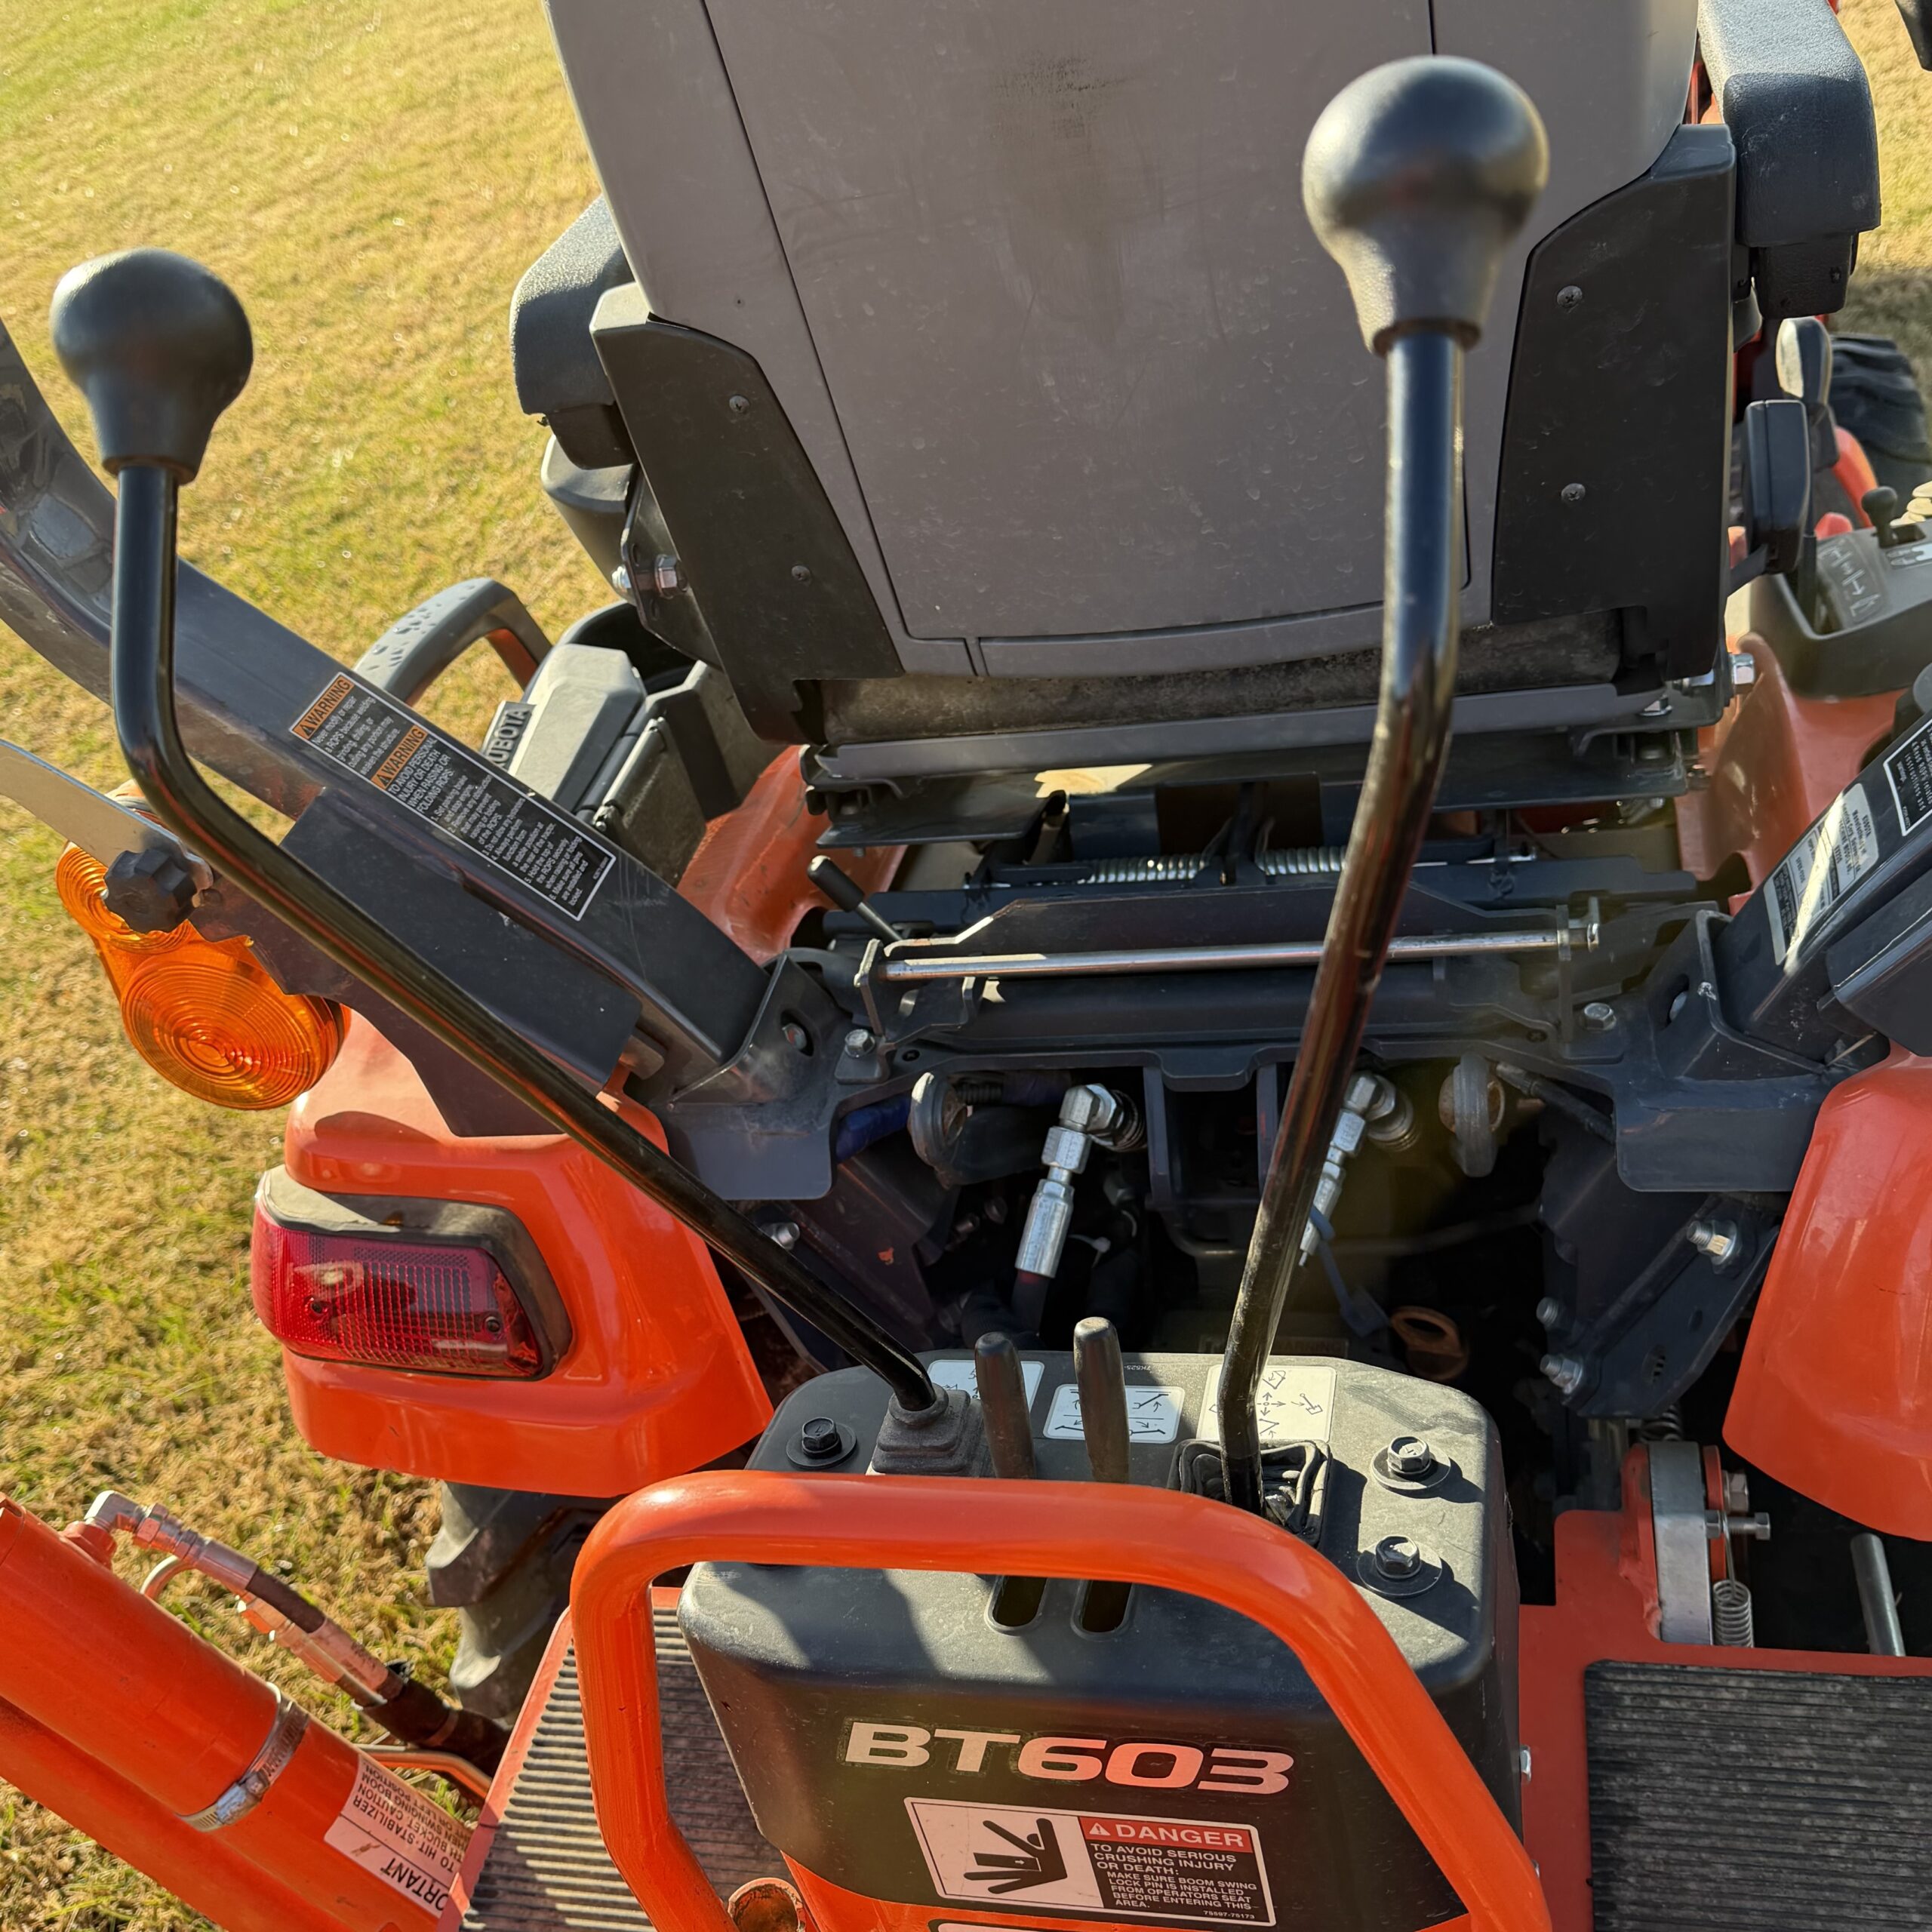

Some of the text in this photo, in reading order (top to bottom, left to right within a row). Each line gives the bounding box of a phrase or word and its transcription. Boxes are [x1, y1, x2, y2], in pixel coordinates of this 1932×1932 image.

[304, 678, 351, 727] WARNING
[326, 731, 345, 749] ROPS
[485, 709, 532, 768] UBOTA
[380, 727, 425, 777] WARNING
[388, 735, 437, 795] TO AVOID PERSONAL
[397, 749, 441, 801] INJURY OR DEATH
[407, 753, 451, 808] WHEN RAISING OR
[417, 785, 441, 814] FOLDING
[844, 1721, 1295, 1795] BT603
[360, 1771, 392, 1800] BOOM
[357, 1782, 404, 1821] CAUTION
[352, 1794, 415, 1845] STABILIZER
[1114, 1824, 1244, 1847] DANGER
[439, 1854, 455, 1872] TO
[1090, 1843, 1237, 1862] TO AVOID SERIOUS
[1093, 1853, 1235, 1871] CRUSHING INJURY
[1096, 1861, 1179, 1875] OR DEATH:
[1106, 1871, 1257, 1890] MAKE SURE BOOM SWING
[1110, 1884, 1251, 1903] FROM OPERATORS SEAT
[1112, 1891, 1160, 1902] BEFORE
[1162, 1896, 1221, 1907] ENTERING
[1114, 1898, 1149, 1908] AREA.
[1180, 1884, 1244, 1896] INSTALLED
